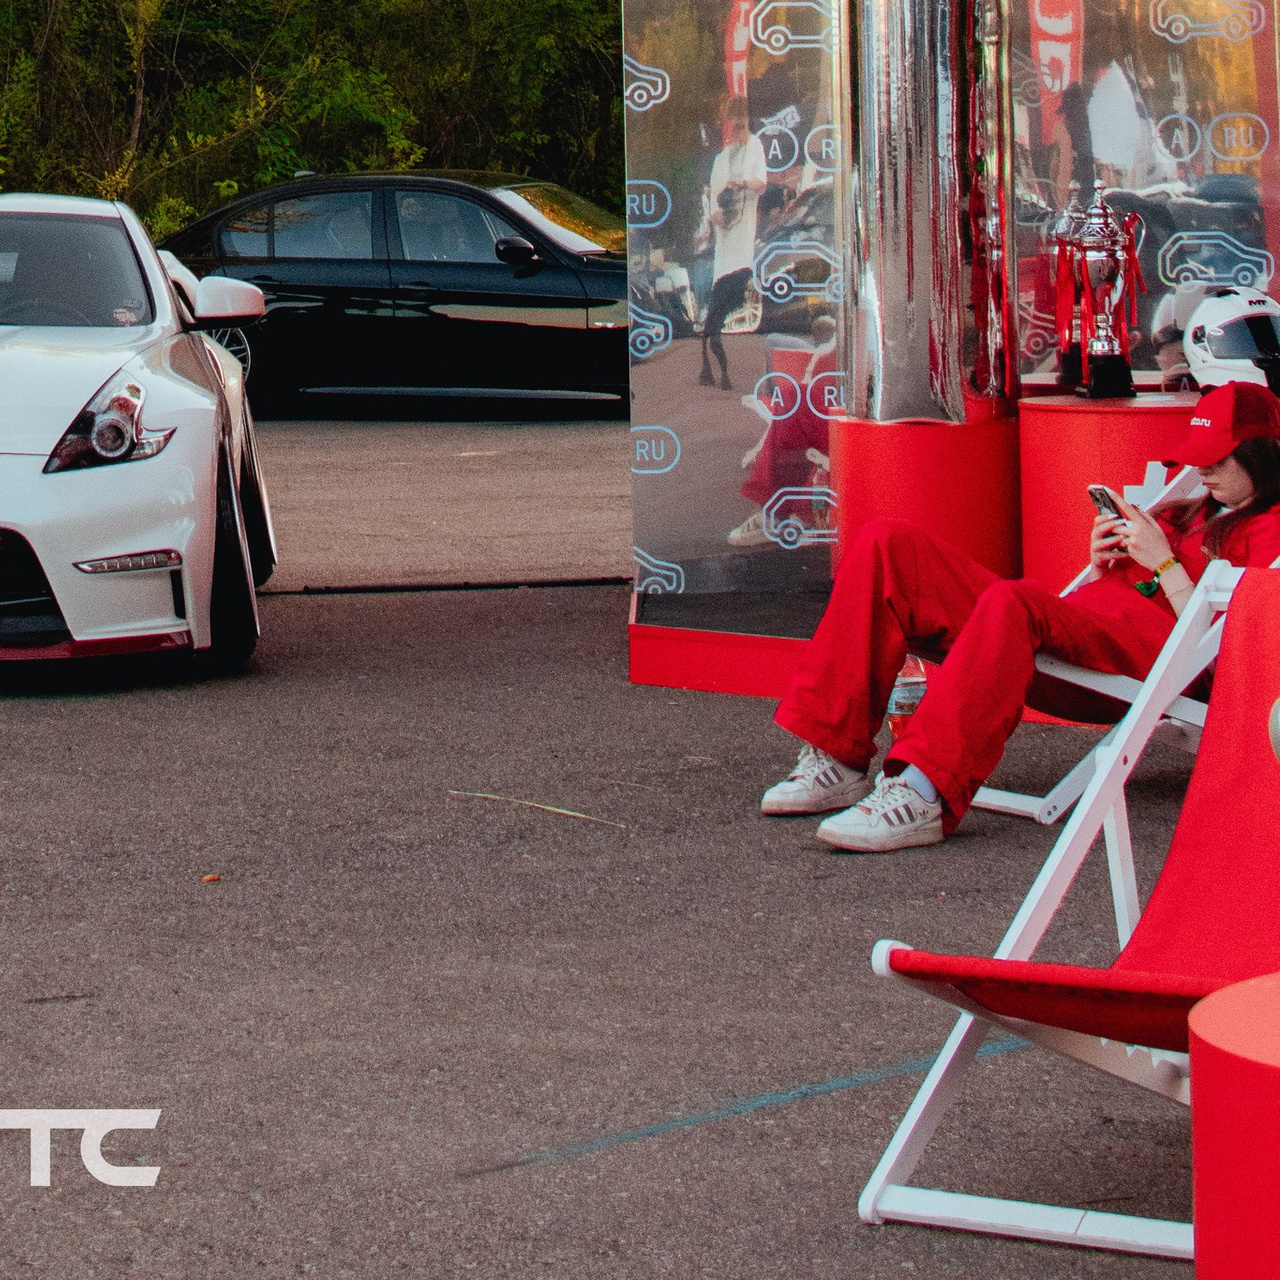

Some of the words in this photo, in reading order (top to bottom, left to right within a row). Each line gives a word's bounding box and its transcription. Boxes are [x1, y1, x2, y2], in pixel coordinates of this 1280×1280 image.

[768, 138, 782, 160] A
[1171, 128, 1185, 149] A
[1224, 126, 1253, 148] RU
[628, 193, 655, 216] RU
[770, 385, 785, 407] A
[635, 439, 665, 462] RU
